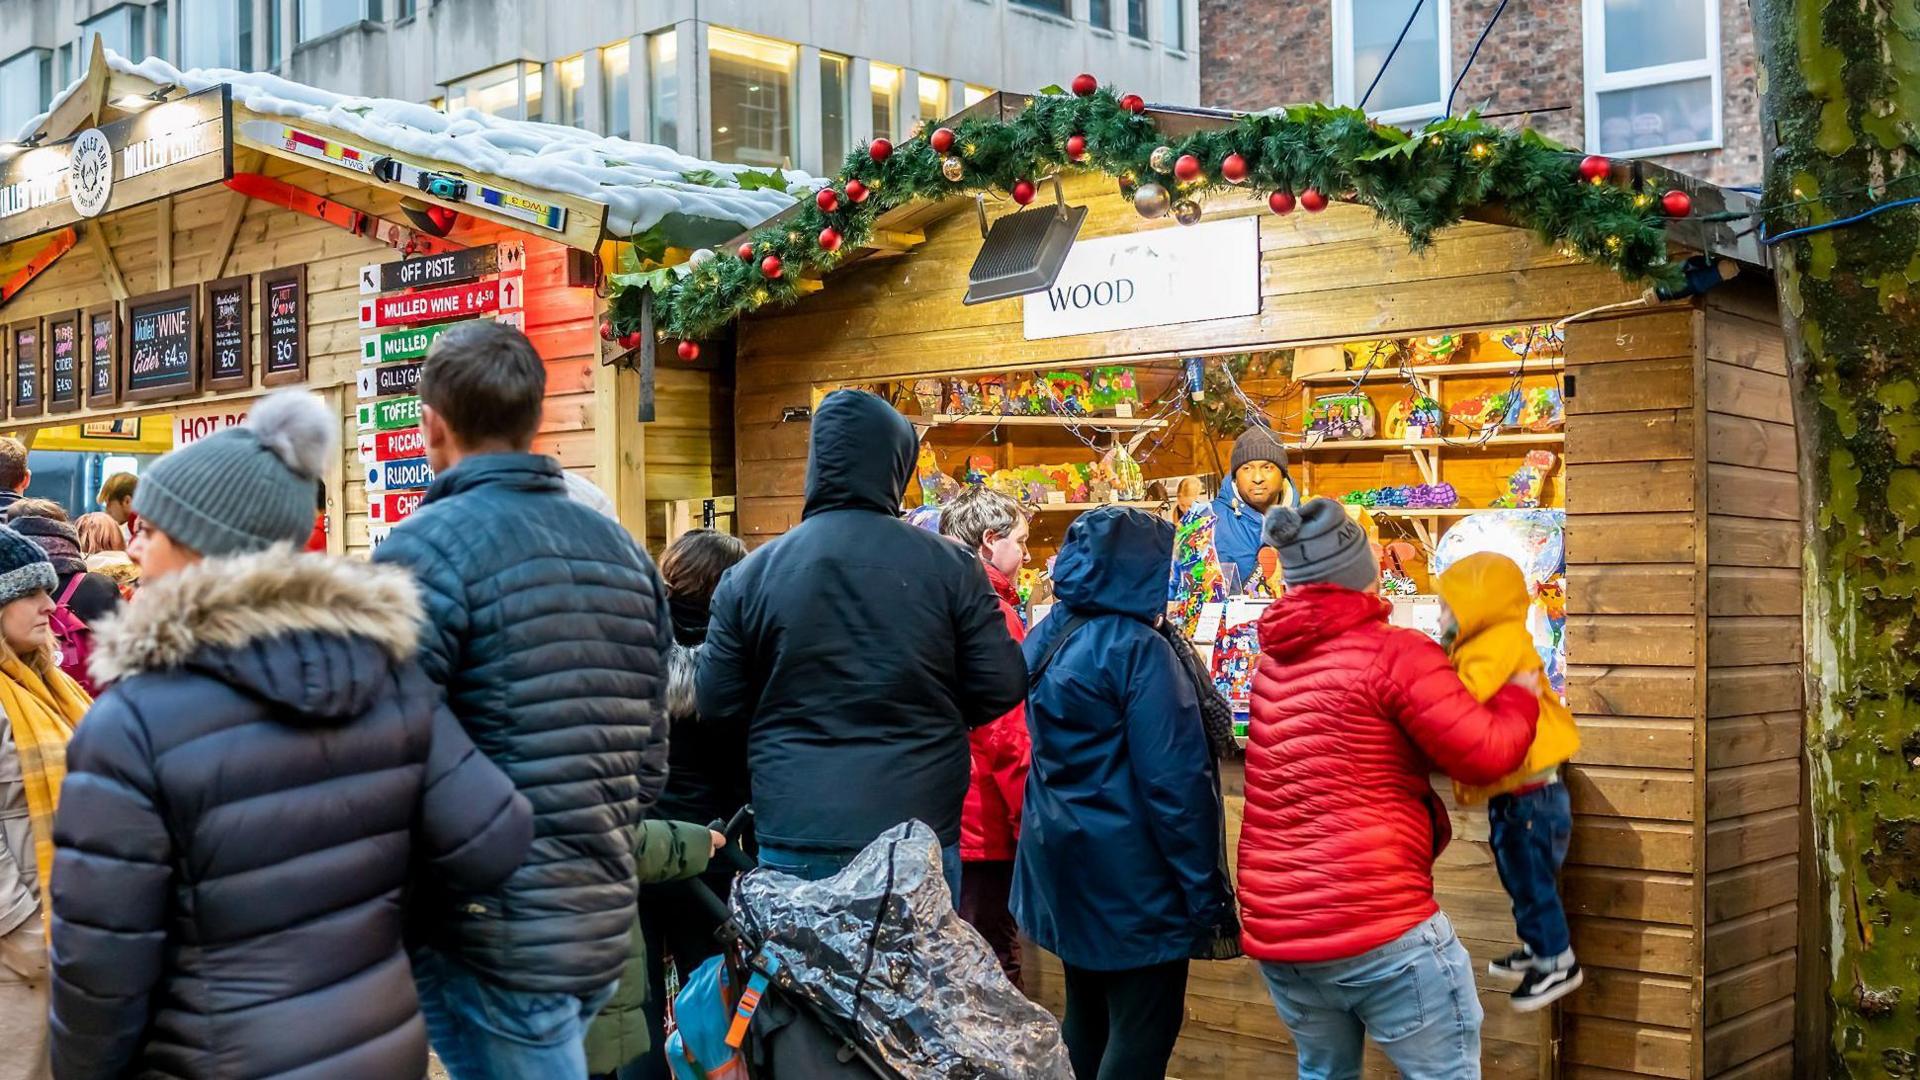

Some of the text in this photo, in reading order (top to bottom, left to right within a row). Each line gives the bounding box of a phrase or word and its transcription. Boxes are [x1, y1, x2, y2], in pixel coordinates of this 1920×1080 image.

[343, 158, 364, 171] TWG
[400, 256, 456, 283] OFF PISTE
[1048, 278, 1134, 312] WOOD
[384, 297, 427, 319] MULLED
[430, 295, 460, 314] WINE
[134, 317, 155, 341] Mulled
[157, 310, 186, 338] WINE
[277, 338, 292, 361] £6
[384, 335, 428, 355] MULLED
[54, 357, 73, 372] CIDER
[133, 346, 160, 374] Cider
[221, 348, 236, 368] £6
[22, 379, 33, 397] £6
[98, 368, 109, 388] £6
[382, 401, 422, 423] TOFFEE
[181, 416, 219, 443] HOT
